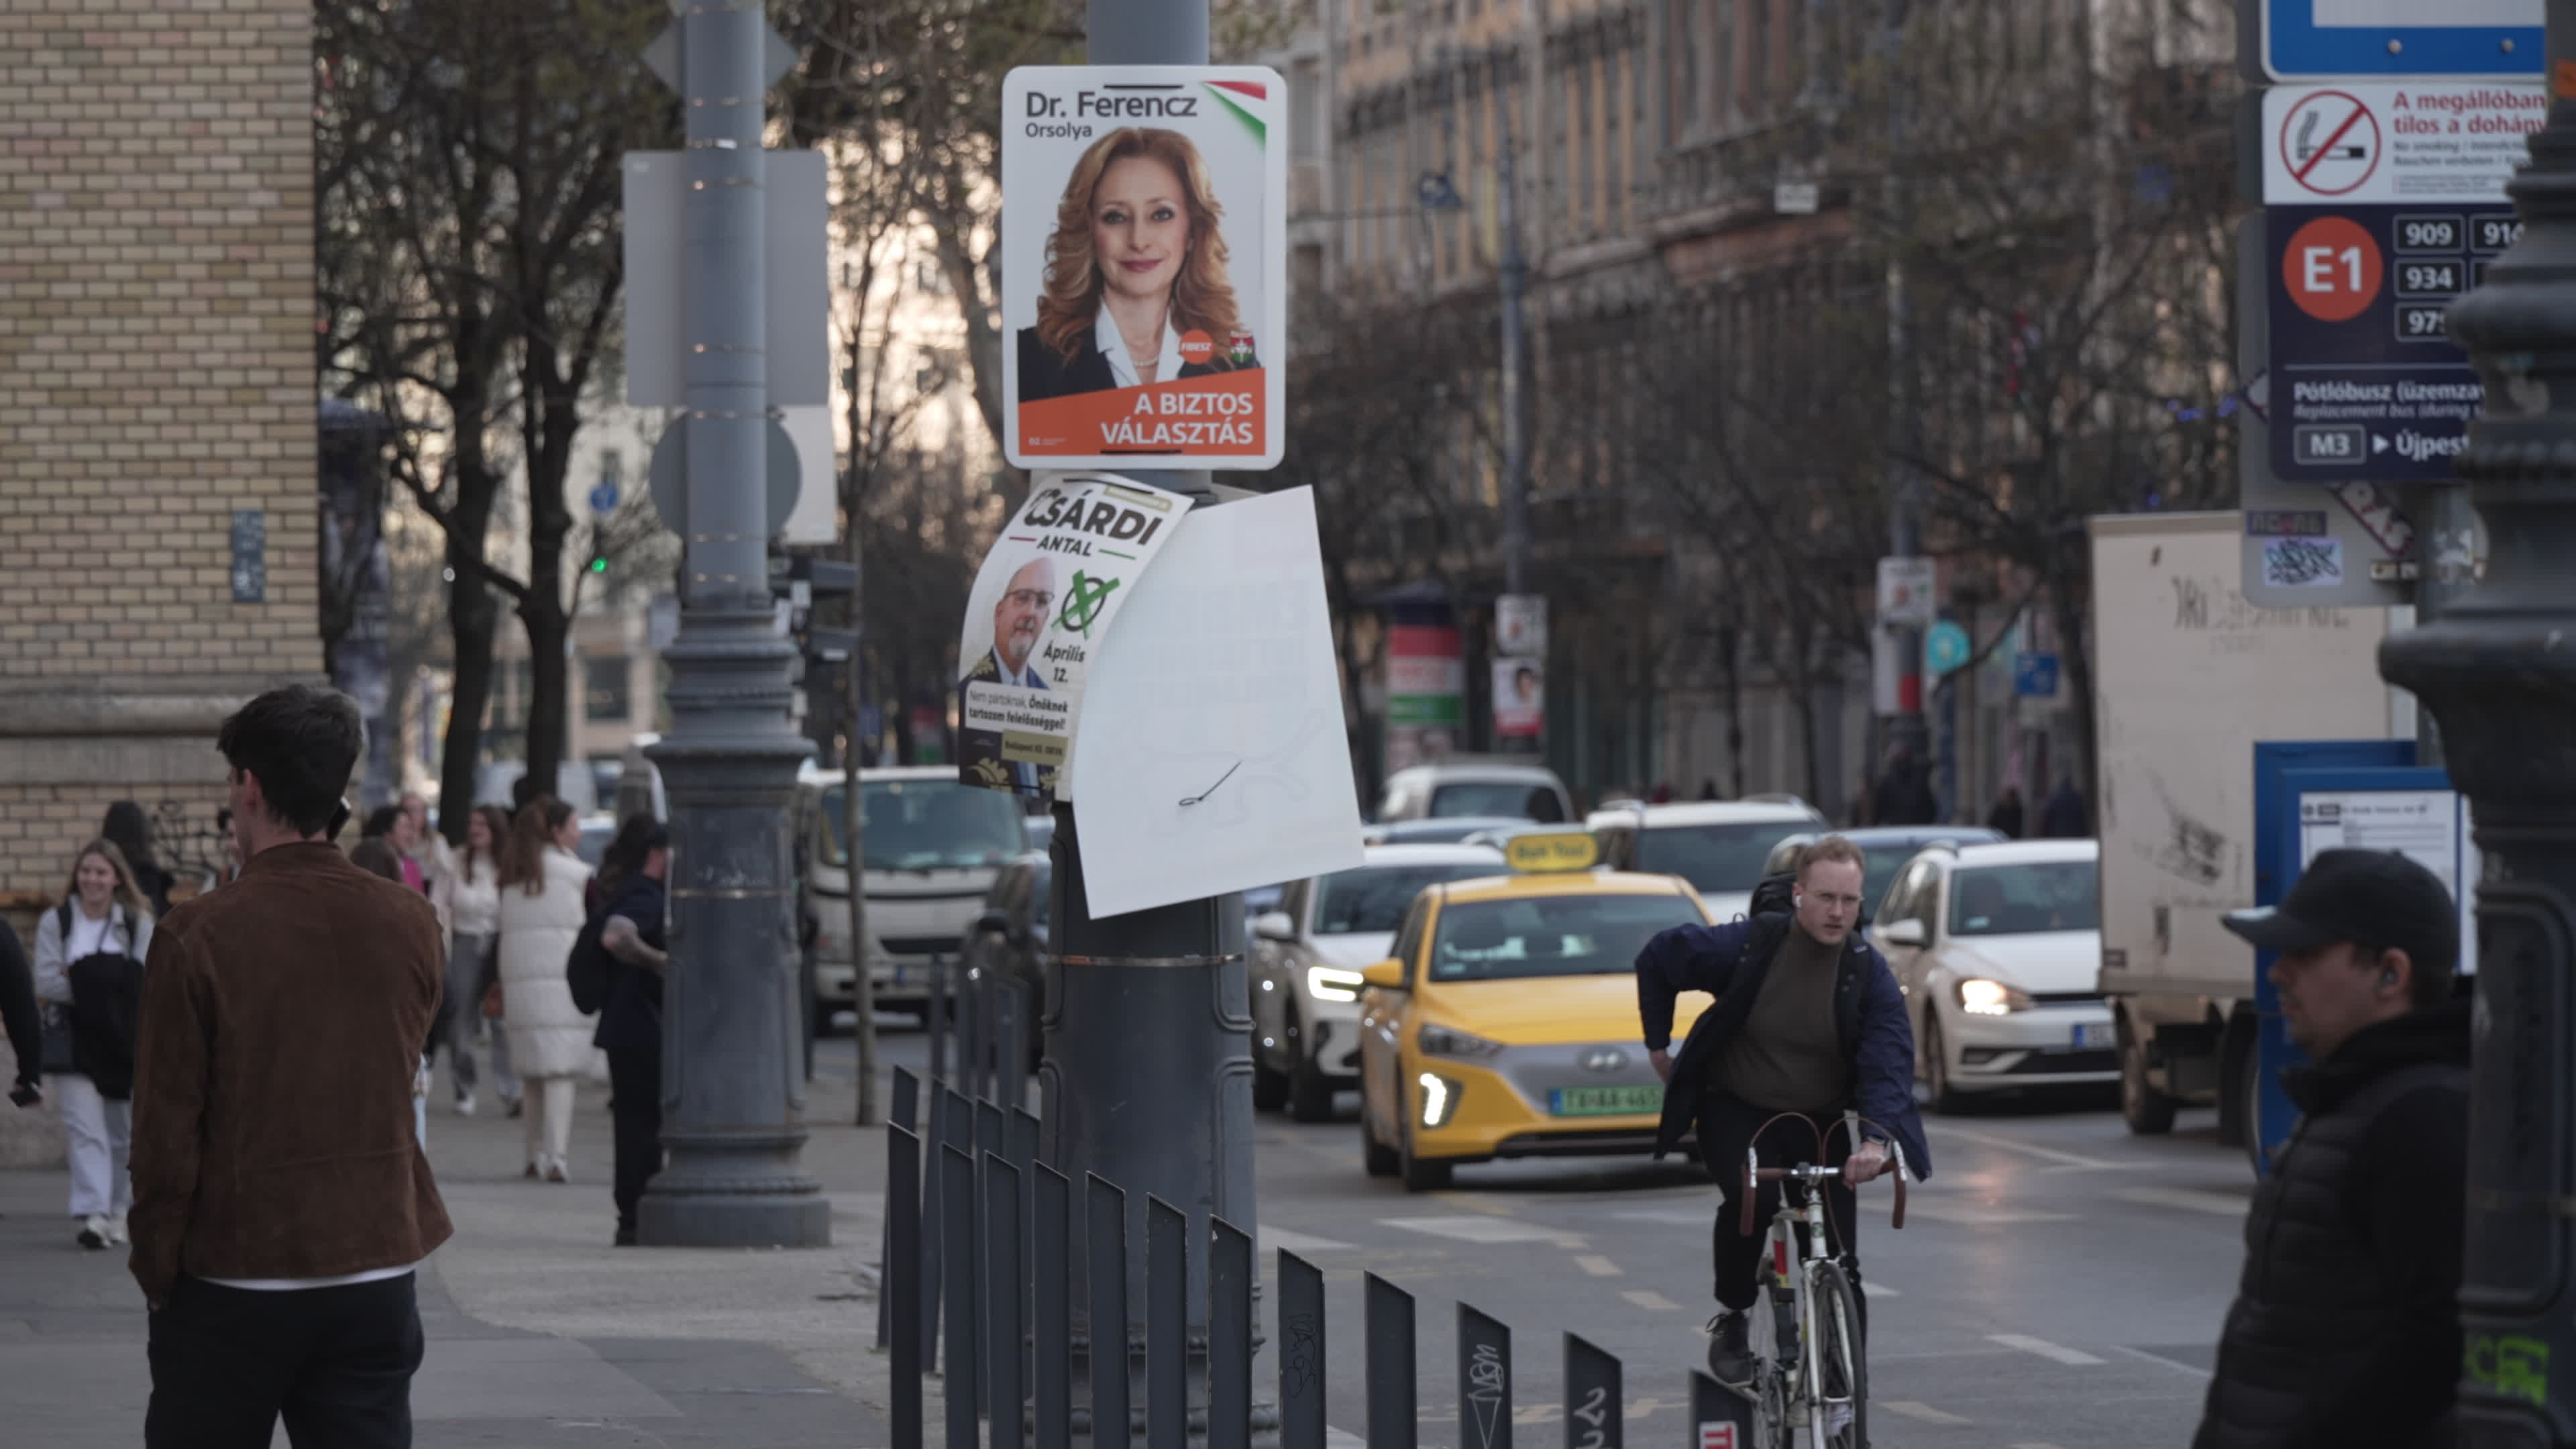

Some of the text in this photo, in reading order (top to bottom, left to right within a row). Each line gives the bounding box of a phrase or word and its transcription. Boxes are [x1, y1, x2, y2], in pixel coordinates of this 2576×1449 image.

[1026, 92, 1197, 117] Dr. Ferencz
[2394, 89, 2546, 115] A megállóban
[1025, 123, 1092, 140] Orsolya
[2394, 115, 2440, 133] tilos
[2448, 119, 2461, 133] a
[2406, 222, 2453, 246] 909
[2303, 246, 2363, 292] E1
[2406, 266, 2453, 290] 934
[1181, 342, 1212, 351] FIDESZ
[2294, 381, 2392, 401] Pótlóbusz
[1134, 392, 1253, 415] A BIZTOS
[2294, 404, 2386, 421] Replacement
[2389, 403, 2416, 418] bus
[1101, 417, 1253, 444] VÁLASZTÁS
[2311, 433, 2351, 456] M3
[1024, 487, 1163, 546] CSÁRDI
[1036, 535, 1093, 557] ANTAL
[1043, 641, 1085, 663] Április
[1054, 667, 1069, 683] 12.
[970, 690, 987, 701] Nem
[1029, 694, 1068, 713] Önöknek
[969, 708, 1005, 721] tartozom
